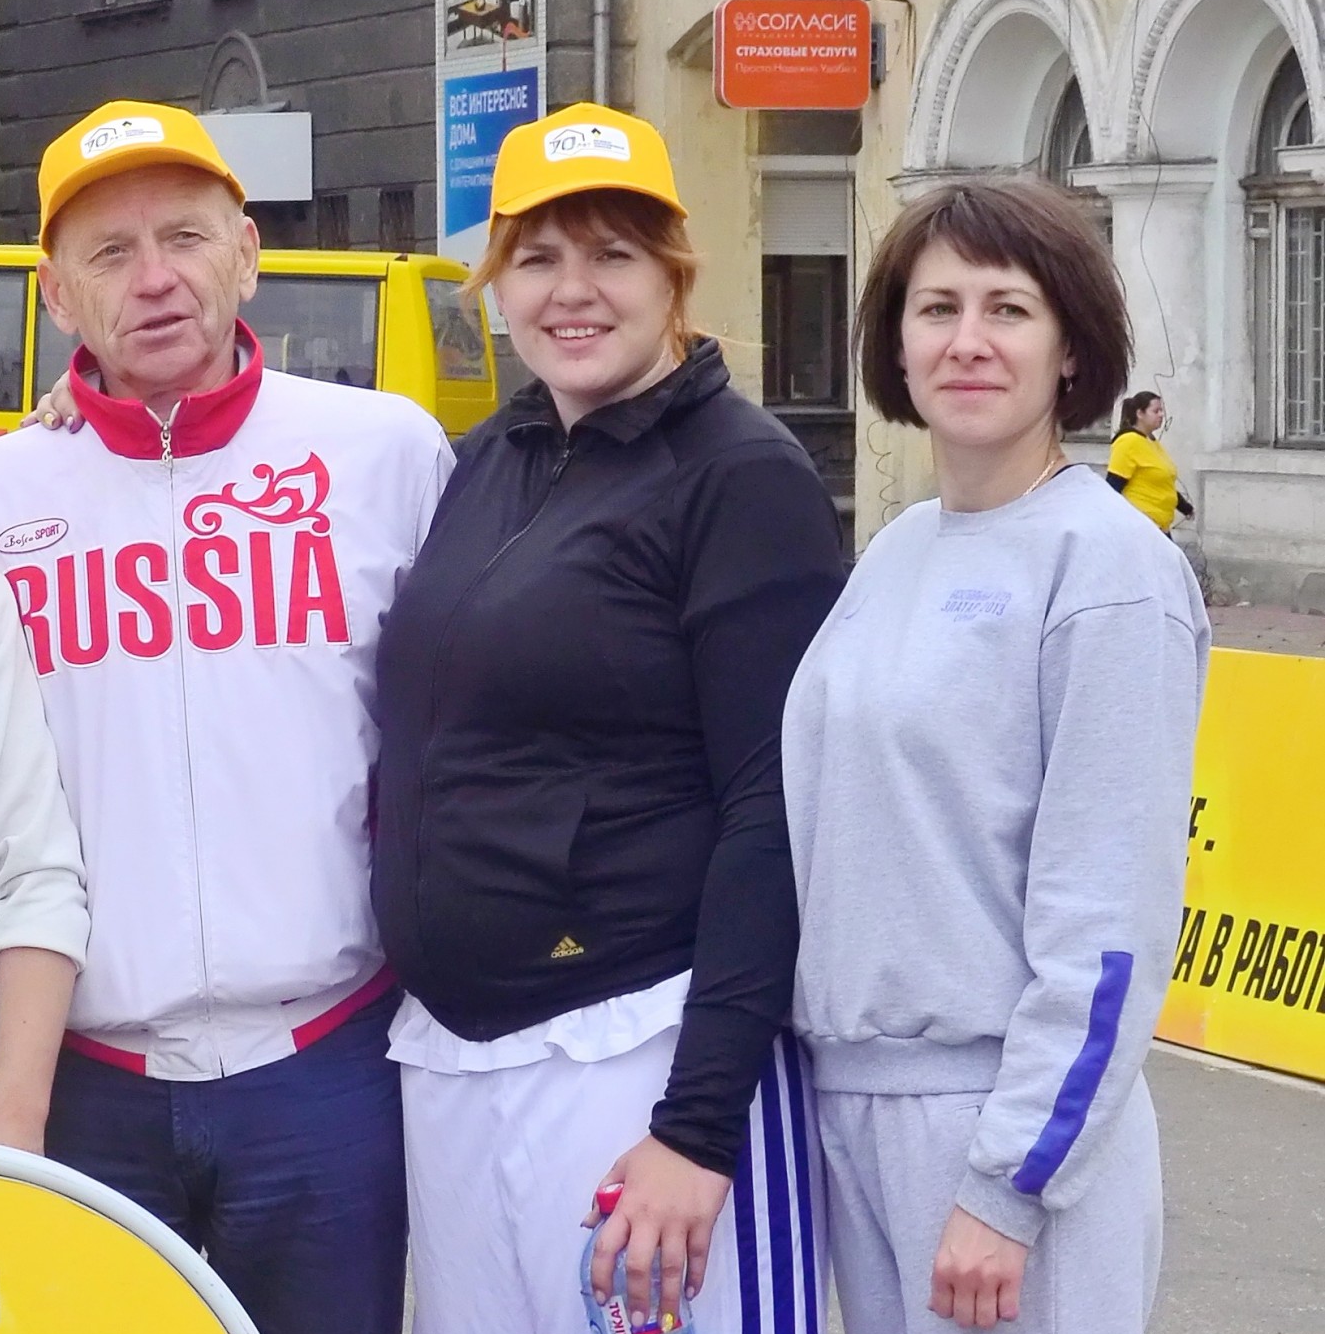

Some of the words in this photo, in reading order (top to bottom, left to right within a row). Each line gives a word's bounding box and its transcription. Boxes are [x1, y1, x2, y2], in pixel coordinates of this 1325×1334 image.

[757, 13, 857, 31] СОГЛАСИЕ
[736, 46, 807, 57] СТРАХОВЫЕ
[810, 46, 857, 57] УСЛУГИ
[469, 85, 528, 115] ИНТЕРЕСНОЕ
[84, 132, 109, 154] 70
[449, 123, 477, 150] ДОМА
[549, 136, 576, 155] 70
[35, 523, 60, 540] SPORT
[4, 530, 352, 677] RUSSIA
[551, 946, 585, 958] adidas
[1199, 913, 1234, 987] В
[1226, 918, 1325, 1015] РАБОТ
